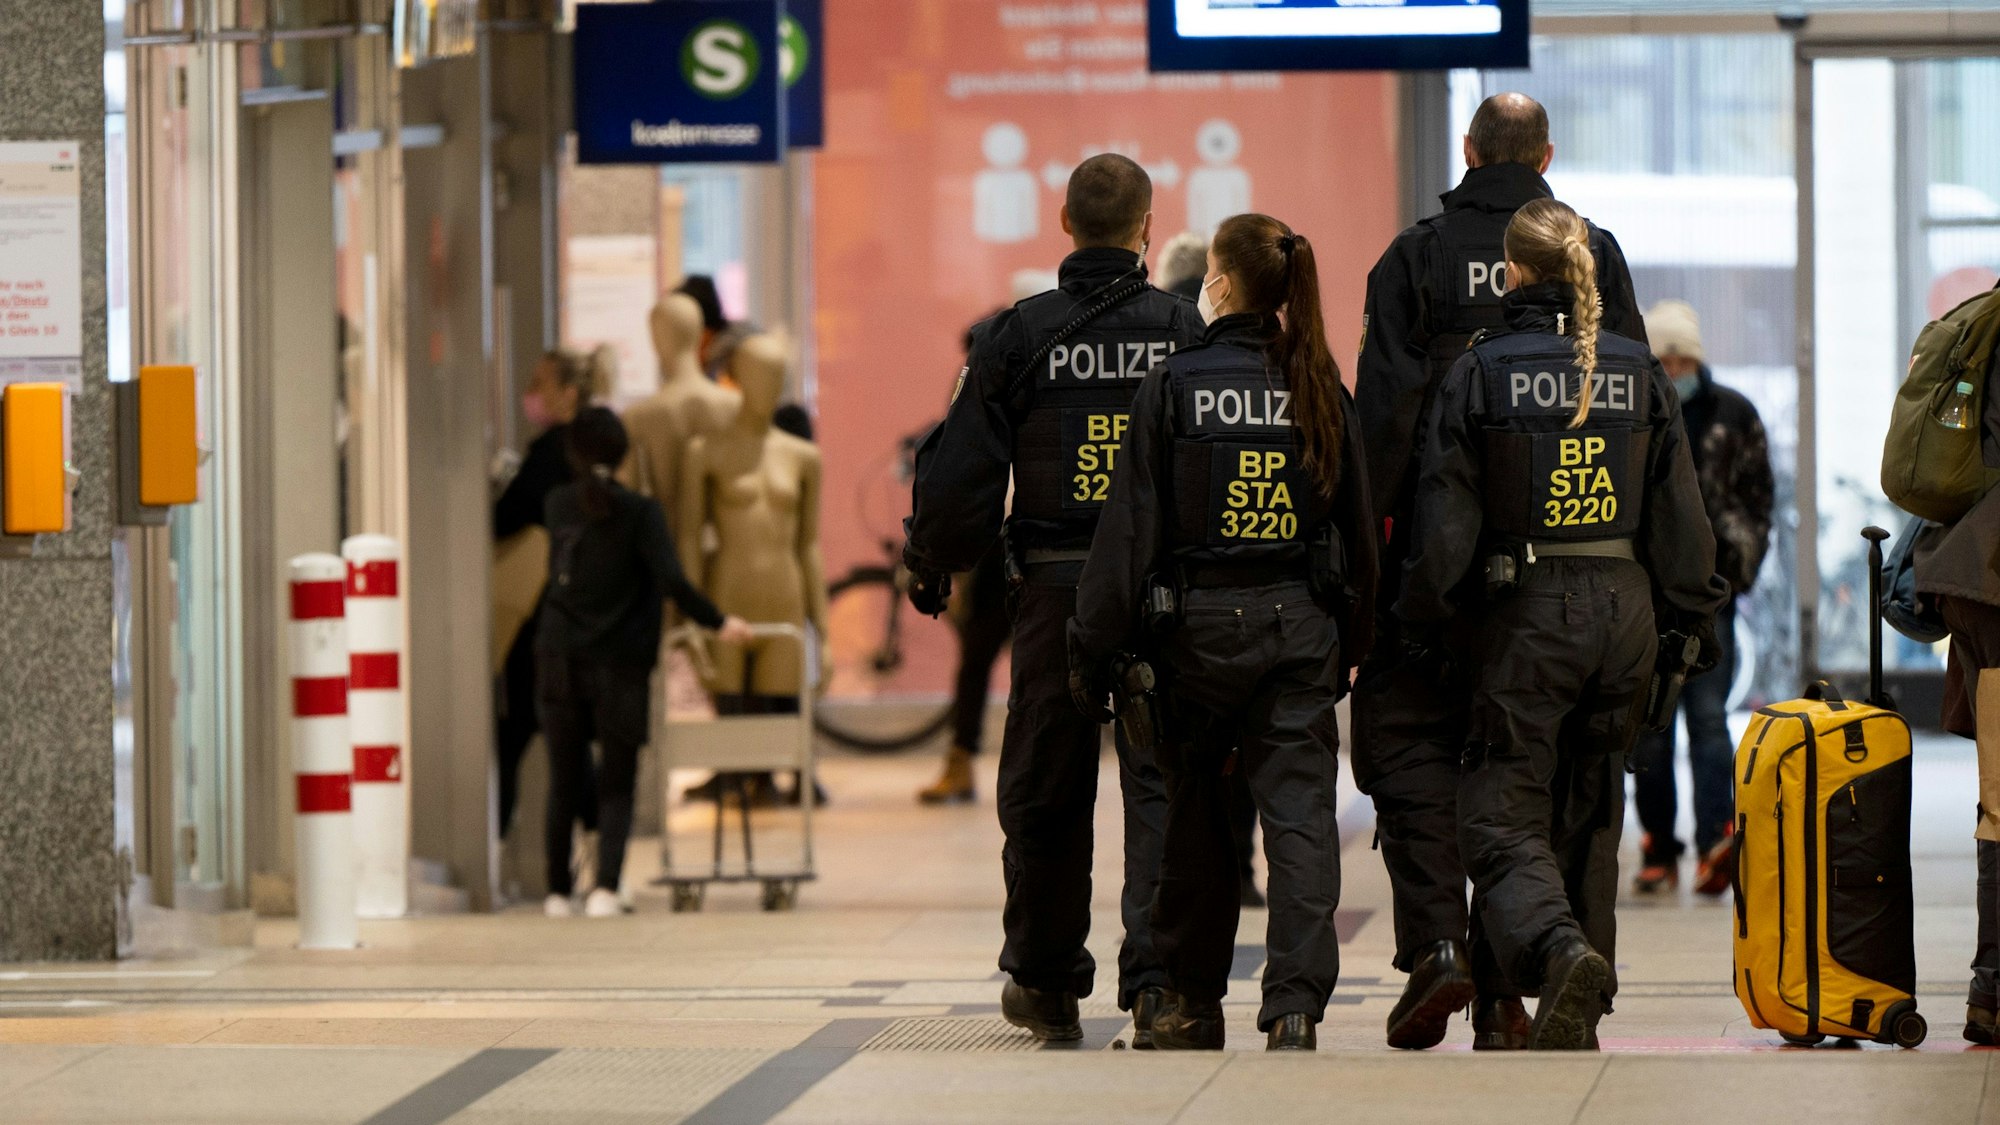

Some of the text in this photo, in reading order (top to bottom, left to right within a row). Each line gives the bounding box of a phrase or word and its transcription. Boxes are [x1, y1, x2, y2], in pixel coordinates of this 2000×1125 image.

[692, 25, 748, 94] S
[1467, 261, 1506, 298] PO
[1194, 388, 1293, 427] POLIZ
[1087, 414, 1130, 442] BP
[1077, 444, 1121, 472] ST
[1239, 450, 1286, 479] BP
[1559, 436, 1606, 466] BP
[1072, 474, 1111, 502] 32
[1226, 480, 1294, 510] STA
[1550, 466, 1614, 498] STA
[1220, 510, 1298, 540] 3220
[1543, 495, 1617, 527] 3220
